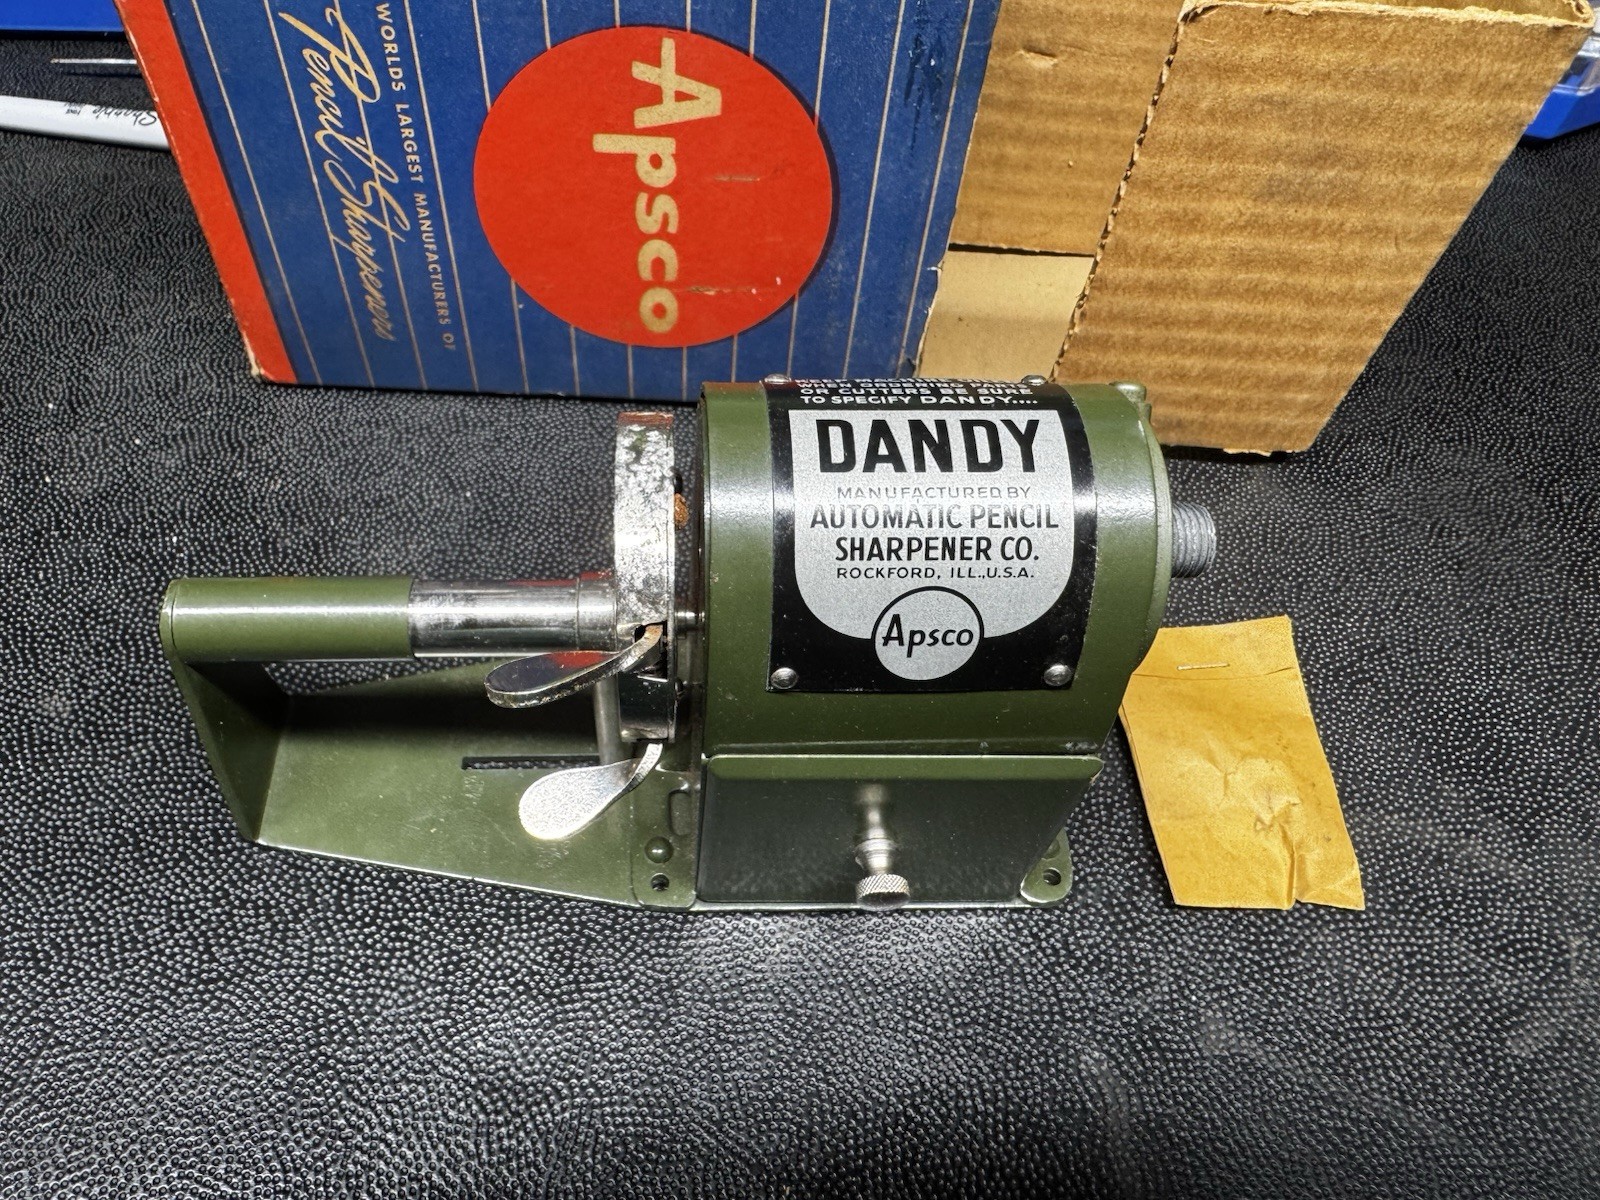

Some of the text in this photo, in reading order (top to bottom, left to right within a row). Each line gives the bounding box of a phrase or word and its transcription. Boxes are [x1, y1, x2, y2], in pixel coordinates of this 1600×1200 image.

[279, 7, 412, 342] Pencil Sharpeners
[374, 3, 407, 92] WORLDS
[395, 103, 424, 183] LARGEST
[413, 192, 453, 327] MANUFACTURERS
[592, 37, 722, 333] Apsco
[800, 396, 826, 404] TO
[831, 396, 911, 404] SPECIFY
[815, 419, 1040, 473] DANDY
[837, 486, 1031, 499] MANUFACTURED BY
[810, 503, 1059, 529] AUTOMATIC PENCIL
[835, 536, 1040, 561] SHARPENER CO.
[836, 567, 942, 580] ROCKFORD,
[882, 613, 974, 658] Apsco
